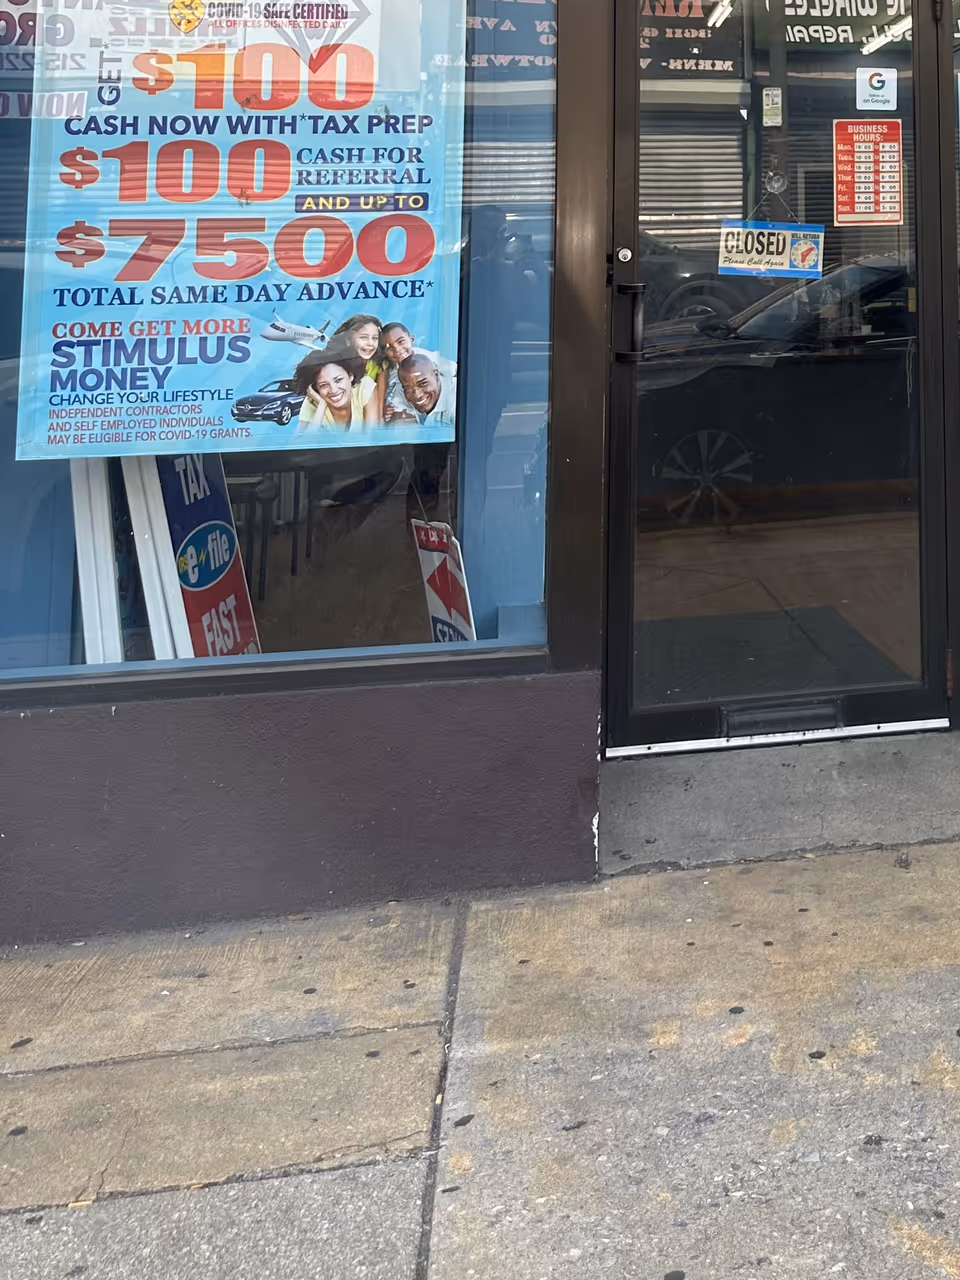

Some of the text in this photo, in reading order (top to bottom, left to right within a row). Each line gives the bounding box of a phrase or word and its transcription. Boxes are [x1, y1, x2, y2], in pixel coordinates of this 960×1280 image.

[207, 1, 262, 19] COVID-19
[263, 3, 291, 20] SAFE
[292, 3, 349, 21] CERTIFIED
[207, 20, 226, 29] ALL
[226, 20, 262, 29] OFFICES
[263, 21, 322, 30] DISINFECTED
[322, 21, 348, 29] DAILY
[131, 41, 376, 111] $100
[64, 115, 139, 136] CASH
[148, 115, 220, 136] NOW
[367, 114, 434, 135] PREP
[847, 124, 888, 133] BUSINESS
[853, 133, 884, 142] HOURS:
[296, 146, 424, 165] CASH FOR
[58, 138, 293, 203] $100
[295, 168, 431, 186] REFERRAL
[302, 195, 425, 210] AND UP TO
[54, 213, 437, 282] $7500
[724, 230, 787, 256] CLOSED
[723, 256, 785, 267] Please Call Again
[53, 286, 145, 308] TOTAL
[150, 284, 228, 305] SAME
[234, 282, 289, 303] DAY
[52, 318, 250, 339] COME GET MORE
[50, 334, 251, 369] STIMULUS
[49, 366, 172, 394] MONEY
[48, 388, 235, 407] CHANGE YOUR LIFESTYLE
[48, 404, 203, 419] INDEPENDENT CONTRACTORS
[48, 416, 224, 432] AND SELF EMPLOYED INDIVIDUALS
[46, 434, 71, 446] MAY
[72, 433, 87, 444] BE
[89, 431, 132, 444] ELIGIBLE
[134, 431, 157, 442] FOR
[158, 429, 208, 441] COVID-19
[174, 453, 211, 506] TAX
[201, 593, 241, 657] FAST
